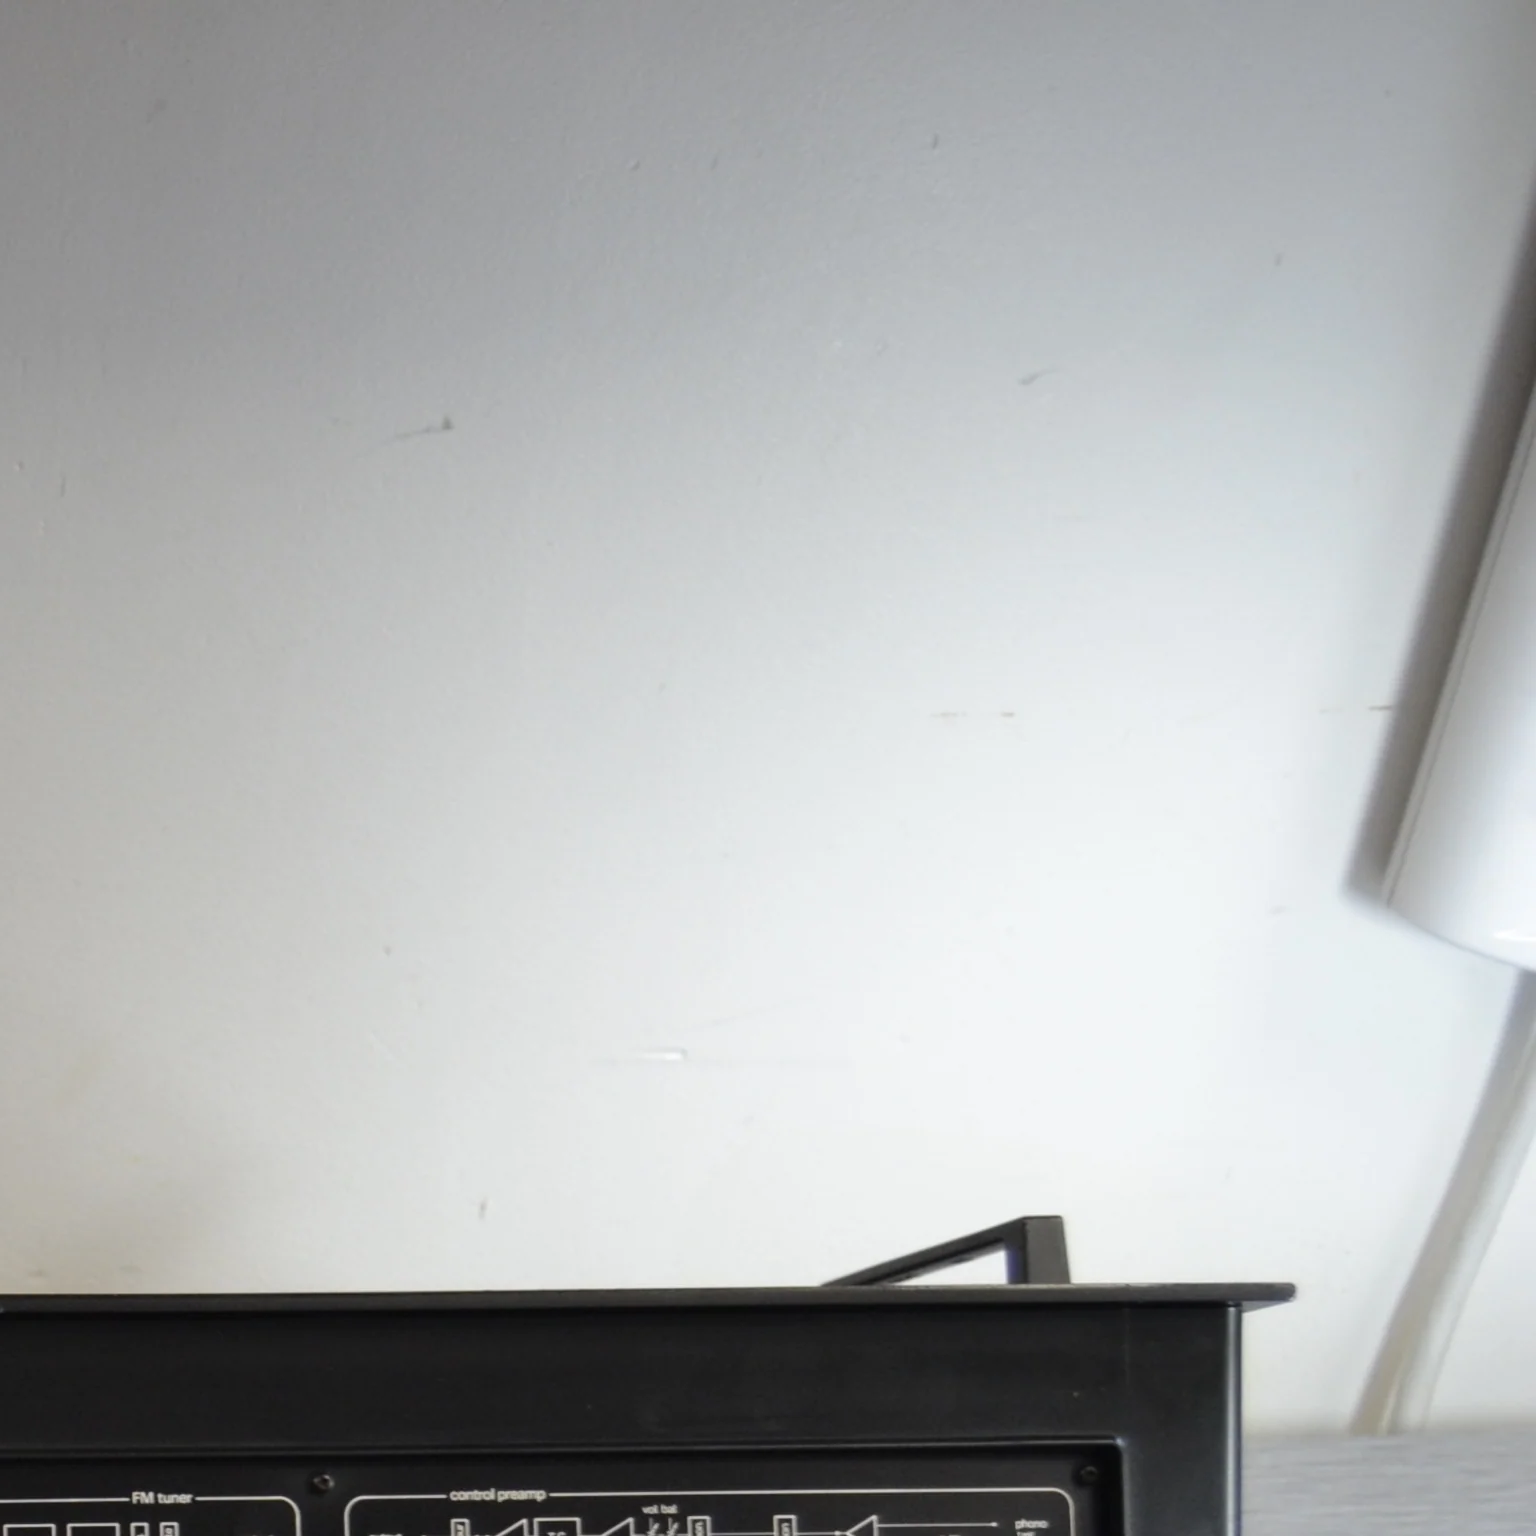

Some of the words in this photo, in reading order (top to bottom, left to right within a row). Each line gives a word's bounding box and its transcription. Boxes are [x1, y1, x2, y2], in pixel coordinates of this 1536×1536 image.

[131, 1491, 154, 1504] FM
[157, 1493, 193, 1504] tuner
[449, 1488, 496, 1501] control
[497, 1490, 547, 1503] preamp
